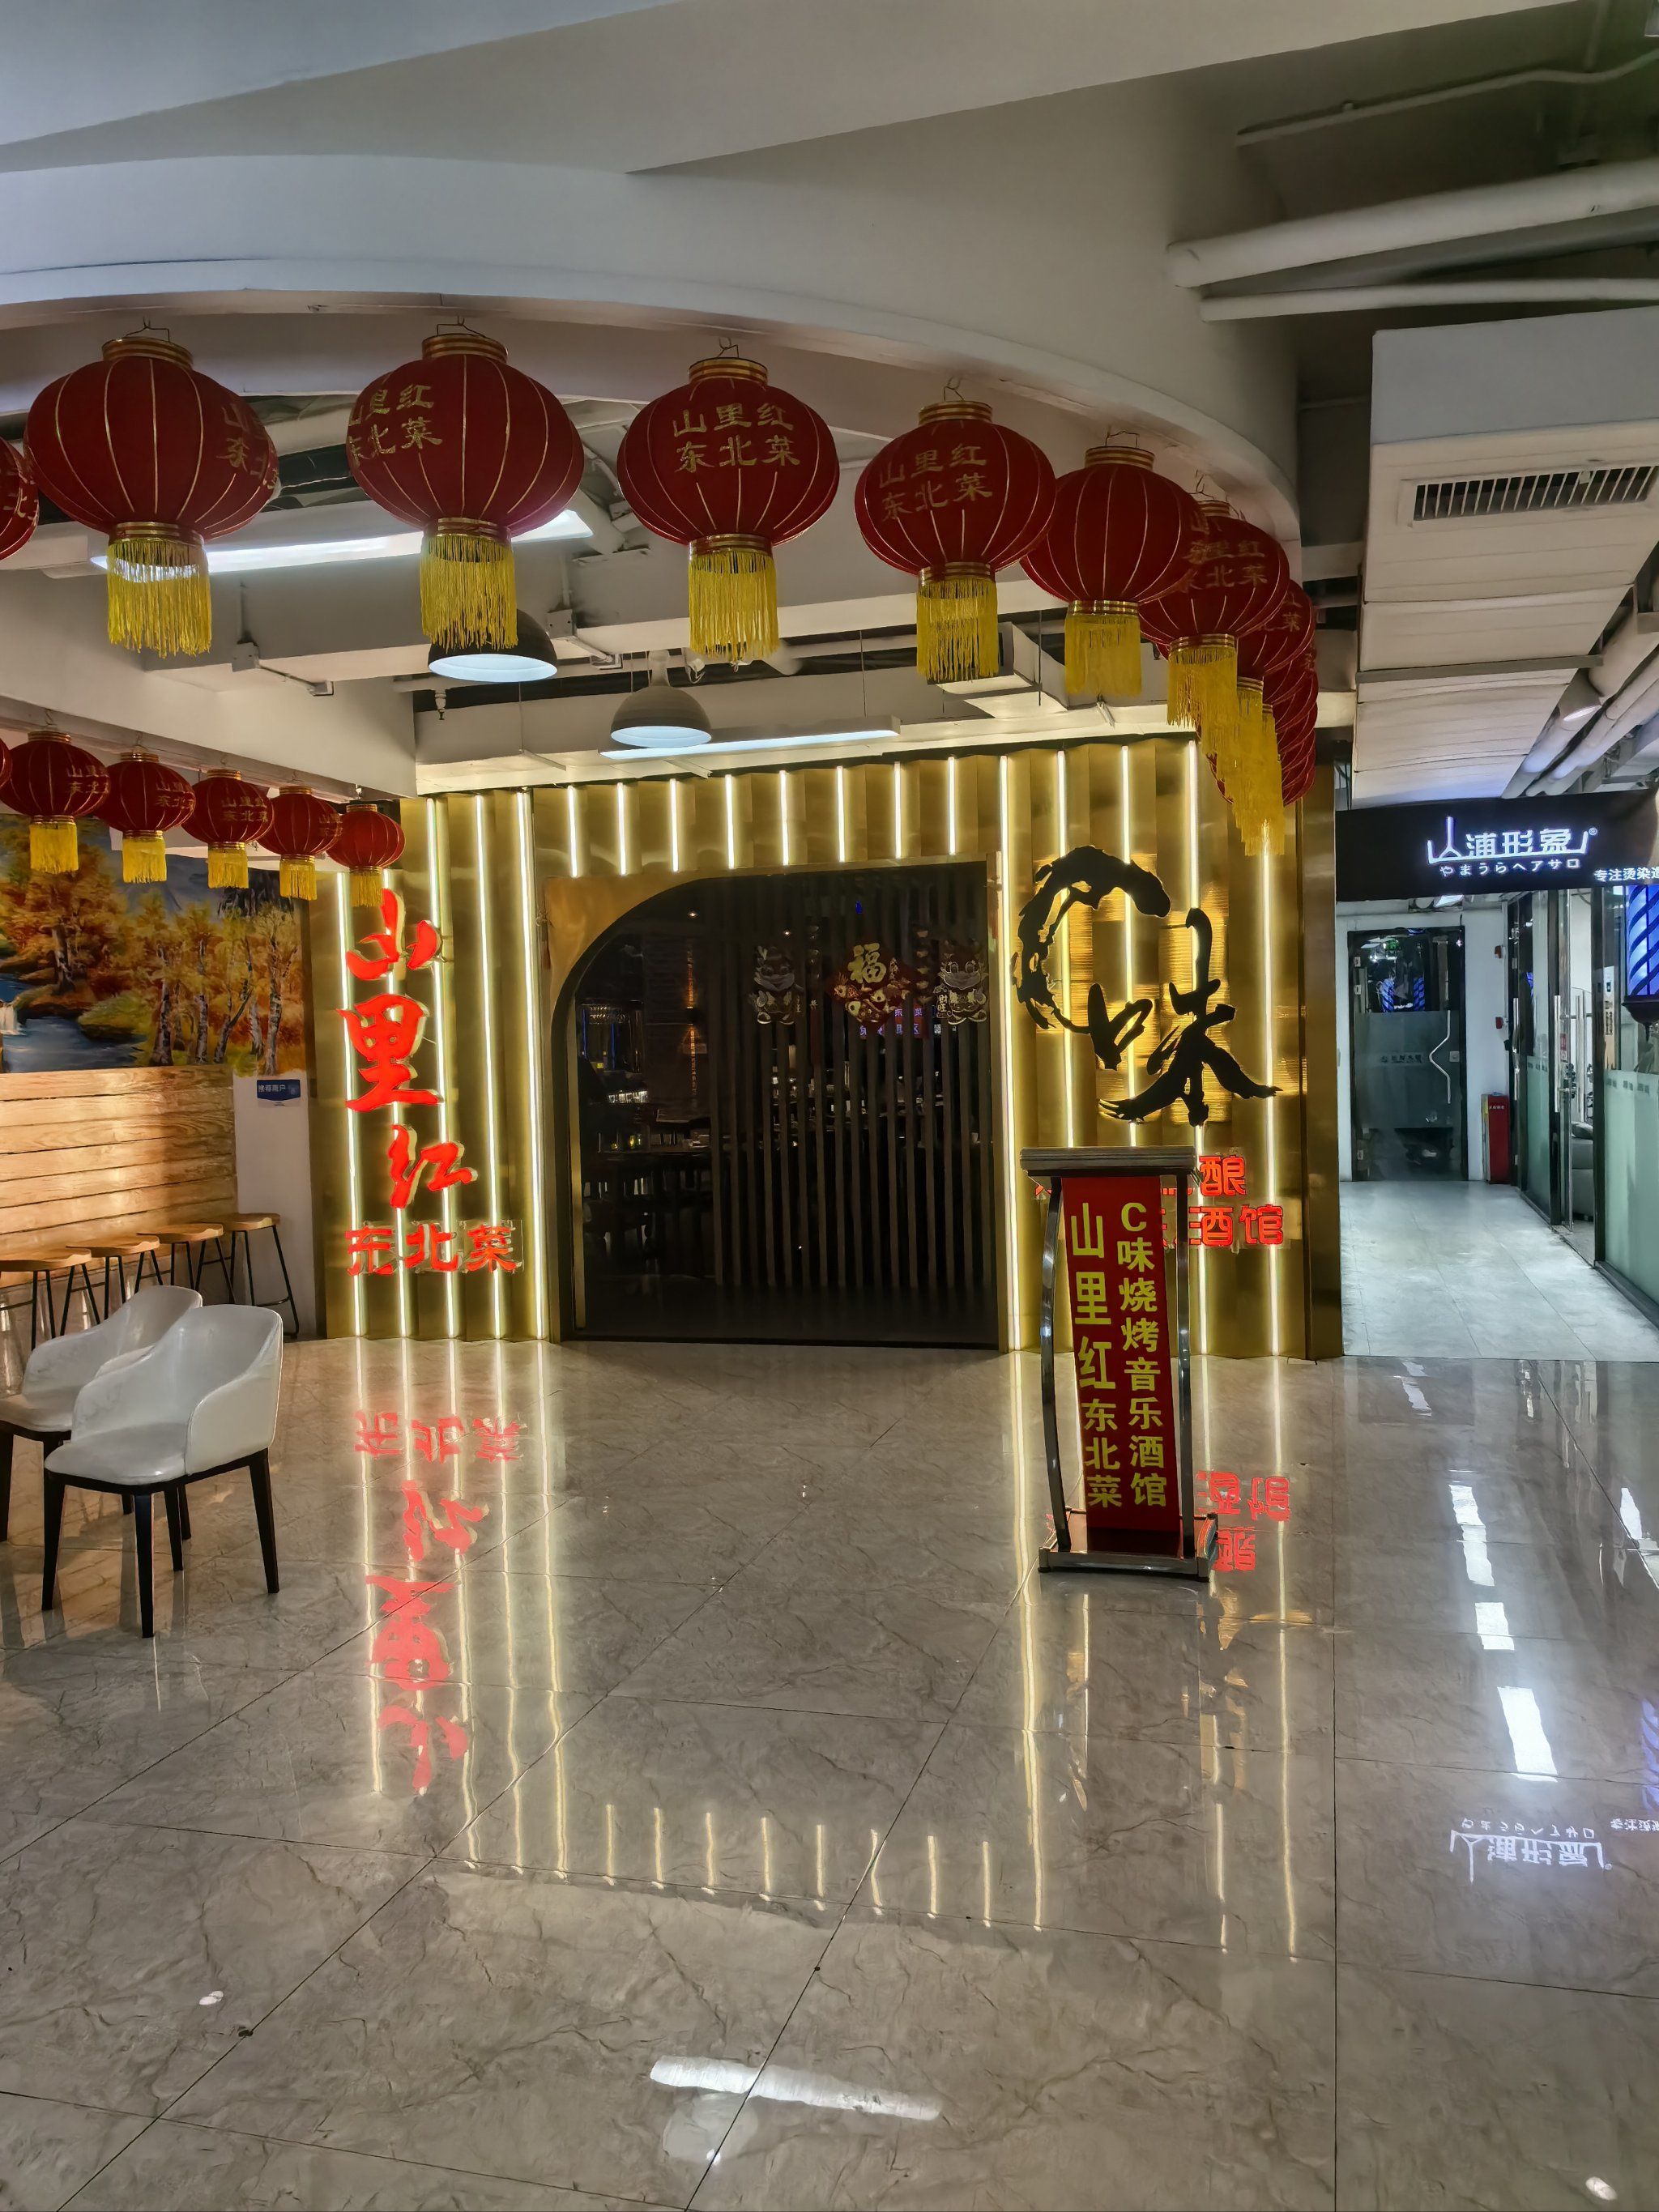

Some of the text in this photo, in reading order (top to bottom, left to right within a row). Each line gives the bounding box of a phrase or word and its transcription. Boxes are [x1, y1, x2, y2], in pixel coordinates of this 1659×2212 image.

[672, 402, 794, 437] 山里红
[674, 435, 800, 473] 东北菜
[879, 443, 987, 488] 山里红
[881, 472, 992, 522] 东北菜
[847, 942, 887, 983] 福
[335, 888, 479, 1209] 山里红
[343, 1223, 520, 1276] 东北菜
[1116, 1202, 1167, 1507] C味烧烤音乐酒馆
